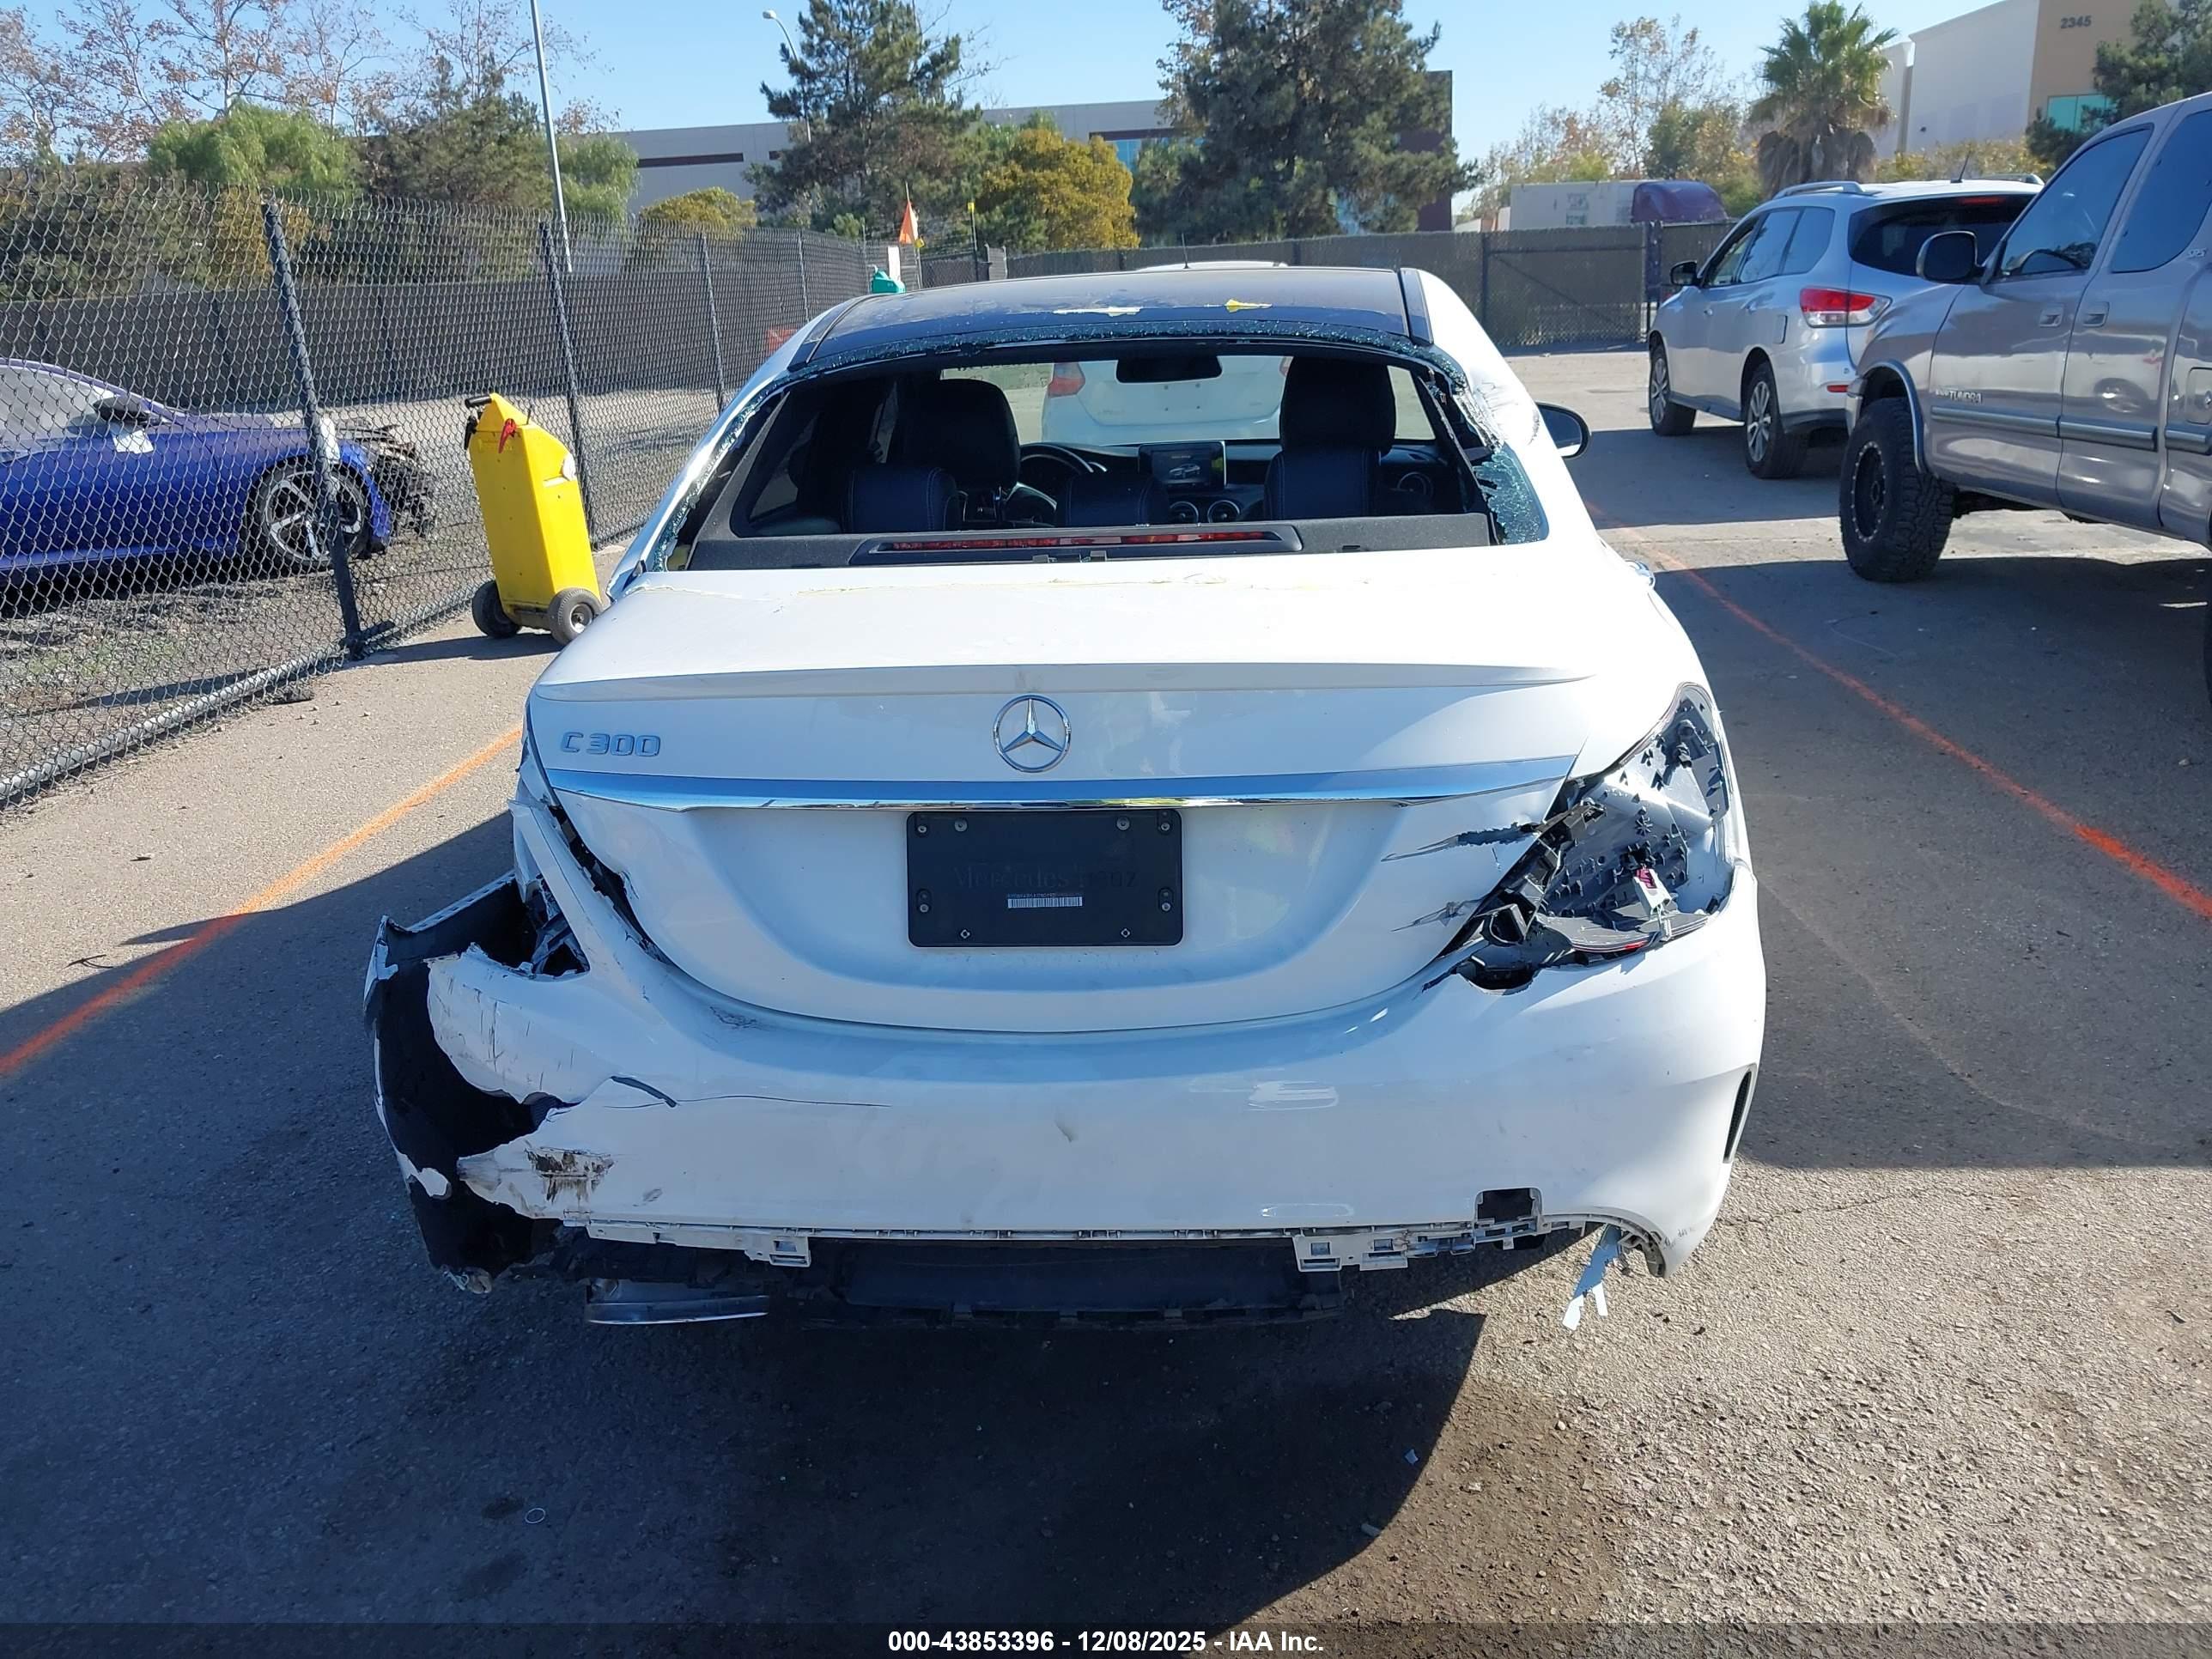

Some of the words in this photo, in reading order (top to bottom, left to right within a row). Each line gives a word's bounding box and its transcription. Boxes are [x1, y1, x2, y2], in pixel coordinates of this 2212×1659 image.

[2060, 15, 2092, 29] 2345
[561, 731, 584, 753] C
[586, 732, 661, 757] 300
